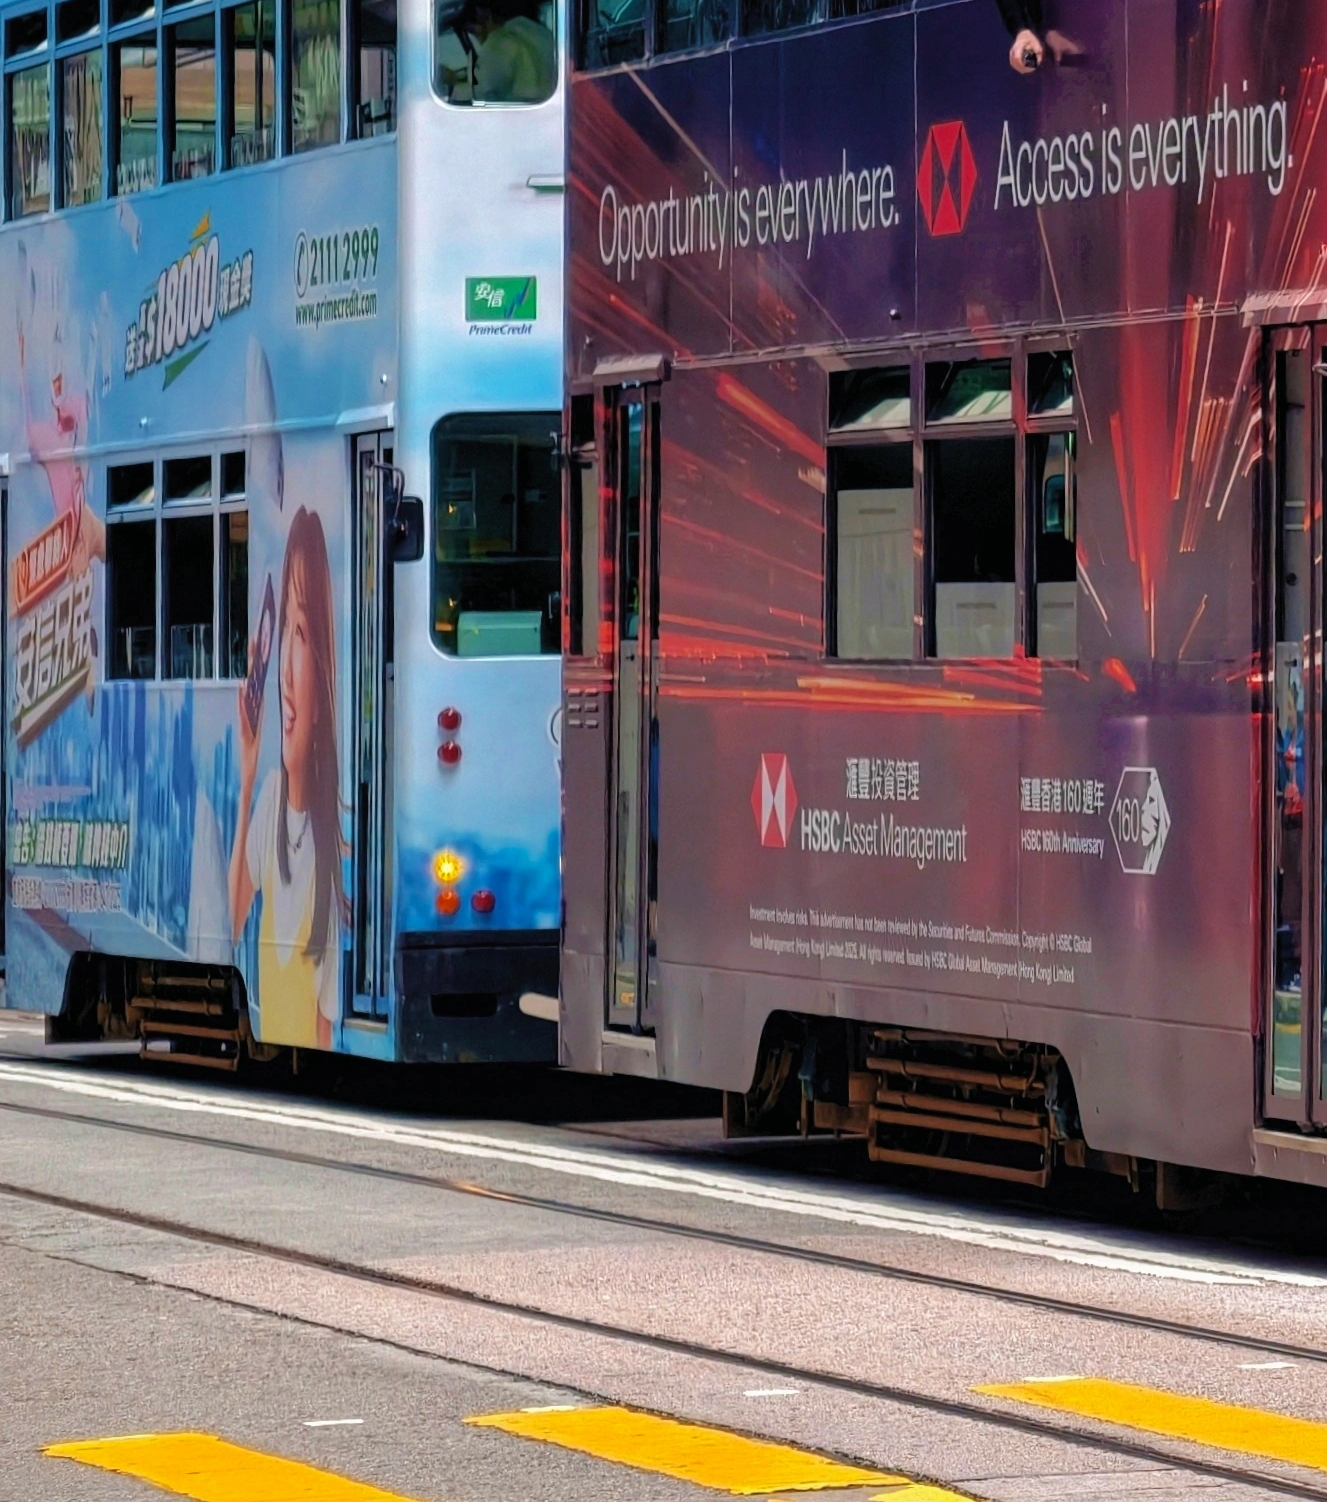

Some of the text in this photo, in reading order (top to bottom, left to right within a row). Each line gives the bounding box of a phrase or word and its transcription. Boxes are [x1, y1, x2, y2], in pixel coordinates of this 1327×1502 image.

[994, 79, 1293, 210] Access is everything.
[600, 148, 900, 283] Opportunity is everywhere.
[310, 227, 379, 287] 2111 2999
[469, 324, 532, 336] PrimeCredit
[802, 808, 967, 870] HSBC Asset Management
[1117, 797, 1140, 842] 160
[1021, 829, 1104, 859] HSBC 160th Anniversary
[887, 917, 910, 936] reviewed
[911, 918, 918, 939] by
[918, 921, 928, 937] the
[928, 921, 953, 939] Securities
[954, 924, 964, 941] and
[1021, 929, 1049, 953] Copyright
[1056, 934, 1072, 951] HSBC
[1073, 936, 1092, 954] Global
[931, 951, 947, 968] HSBC
[948, 952, 965, 971] Global
[965, 955, 980, 972] Asset
[981, 956, 1018, 979] Management
[1052, 963, 1074, 983] Limited
